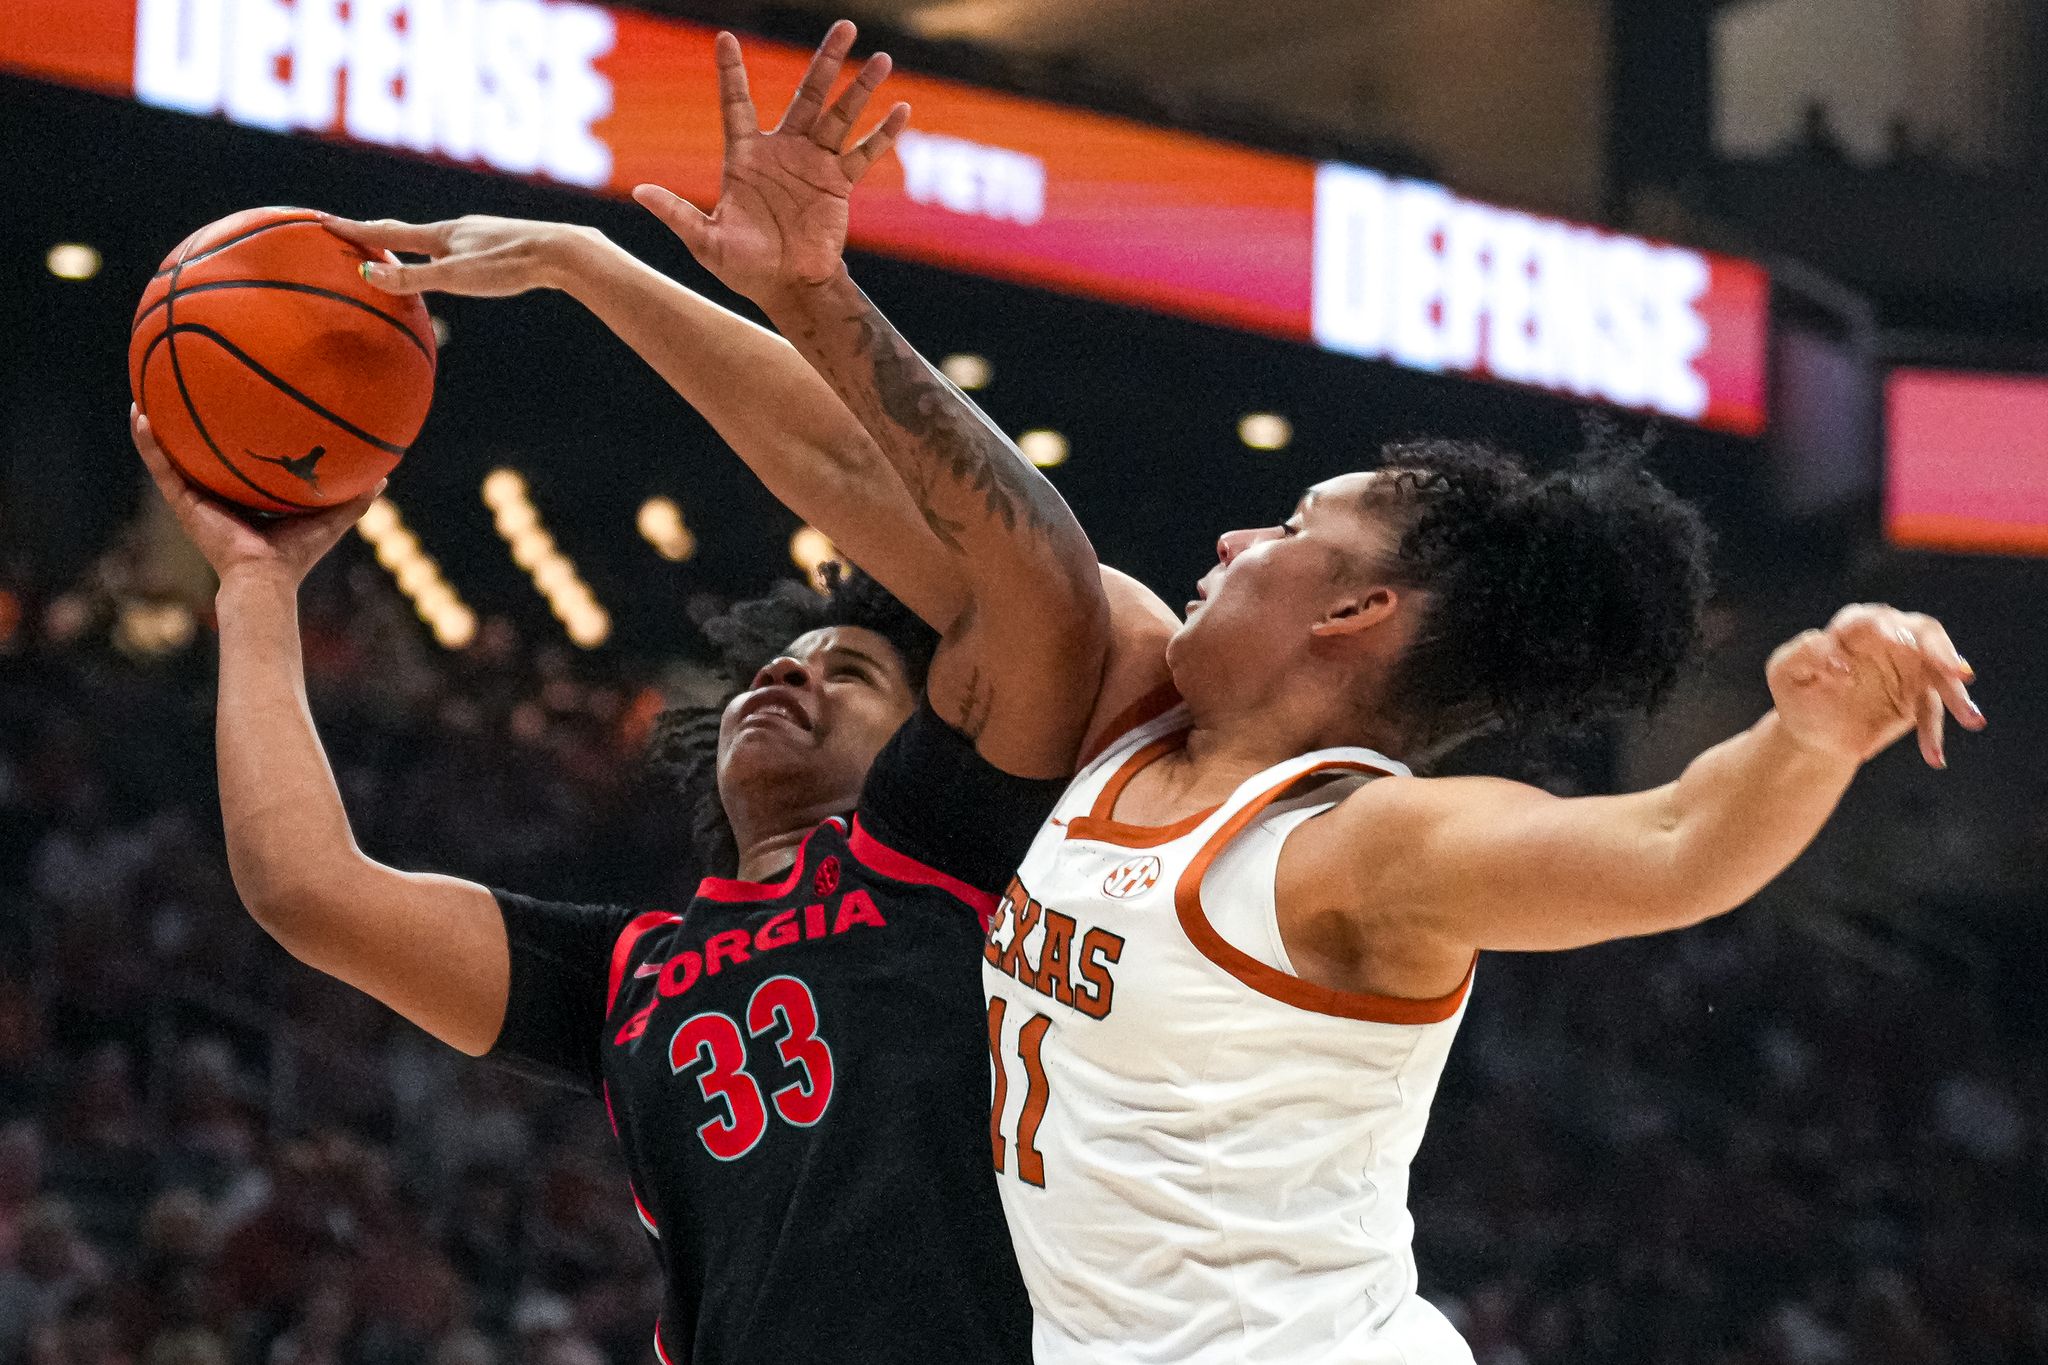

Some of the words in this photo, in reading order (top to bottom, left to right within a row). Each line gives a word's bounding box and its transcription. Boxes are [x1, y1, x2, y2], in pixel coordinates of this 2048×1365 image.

[1312, 161, 1710, 420] DEFENSE
[614, 888, 887, 1045] GORGIA
[984, 872, 1125, 1021] EXAS
[669, 974, 834, 1161] 33
[988, 995, 1051, 1188] 11
